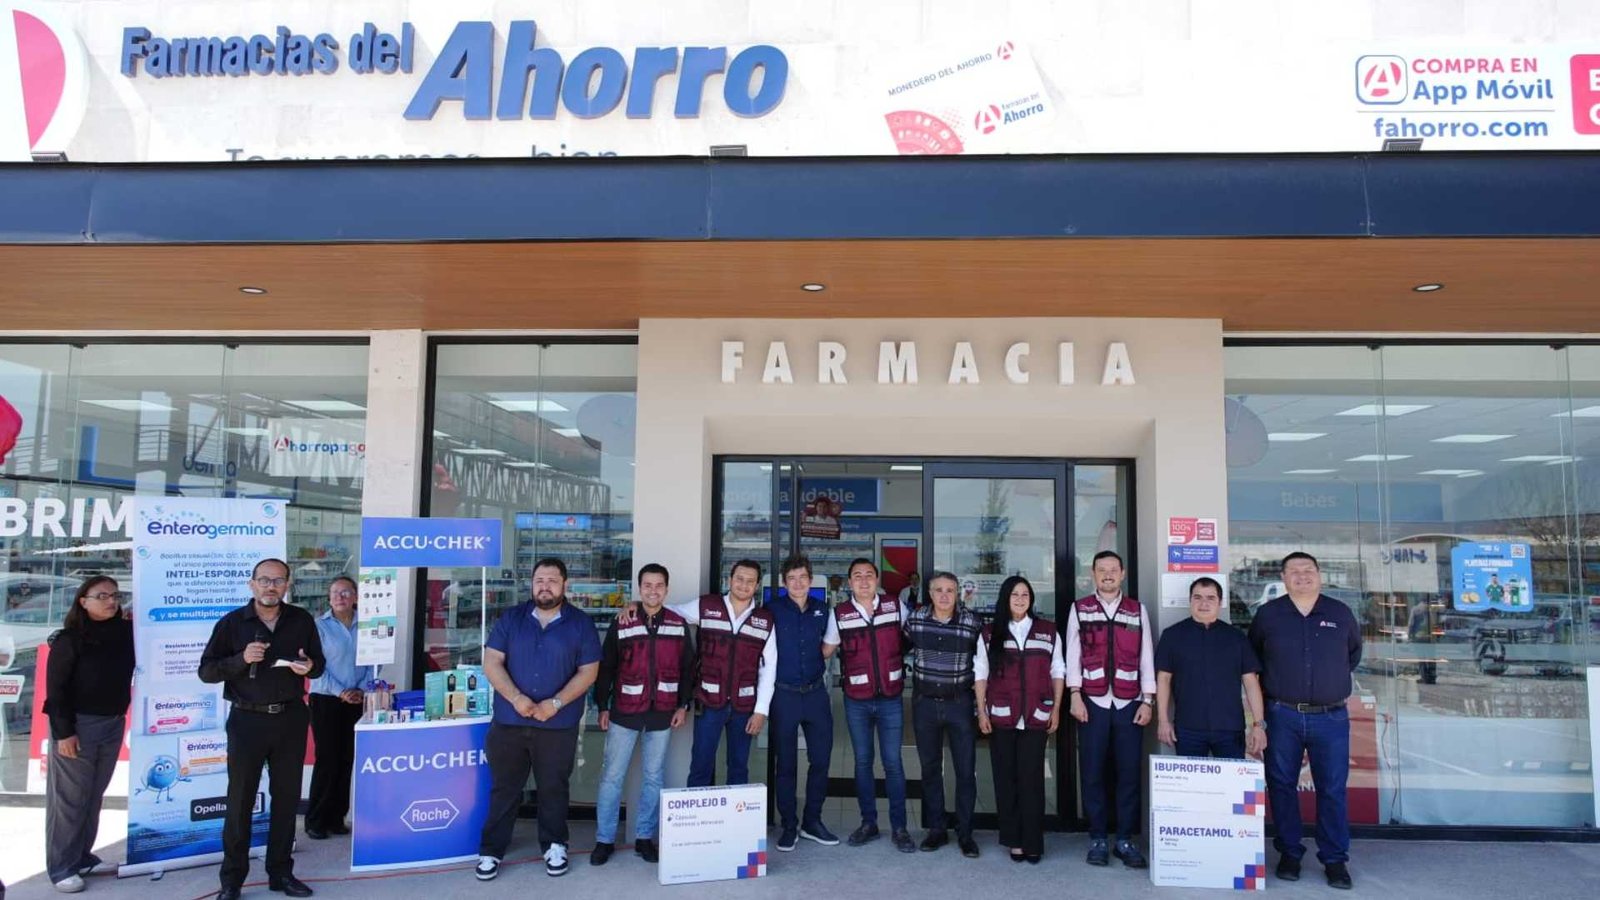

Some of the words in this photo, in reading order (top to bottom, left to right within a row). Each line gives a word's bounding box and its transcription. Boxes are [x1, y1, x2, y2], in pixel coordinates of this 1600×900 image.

[120, 26, 338, 77] Farmacias
[349, 22, 413, 74] del
[404, 20, 789, 121] Ahorro
[1412, 58, 1505, 74] COMPRA
[1511, 58, 1538, 73] EN
[888, 73, 936, 96] MONEDERO
[938, 67, 954, 79] DEL
[956, 53, 993, 72] AHORRO
[1412, 80, 1467, 105] App
[1476, 79, 1554, 100] Móvil
[1003, 103, 1044, 125] Ahorro
[1374, 118, 1549, 137] fahorro.com
[721, 341, 1136, 386] FARMACIA
[147, 521, 276, 540] enterogermina
[166, 570, 251, 578] INTELI-ESPORAS
[163, 596, 190, 605] 100%
[155, 701, 211, 710] enterogermina
[1155, 762, 1222, 774] IBUPROFENO
[194, 803, 227, 815] Opella
[667, 798, 718, 810] COMPLEJO
[720, 797, 727, 806] B
[412, 807, 450, 823] Roche
[1159, 826, 1234, 838] PARACETAMOL
